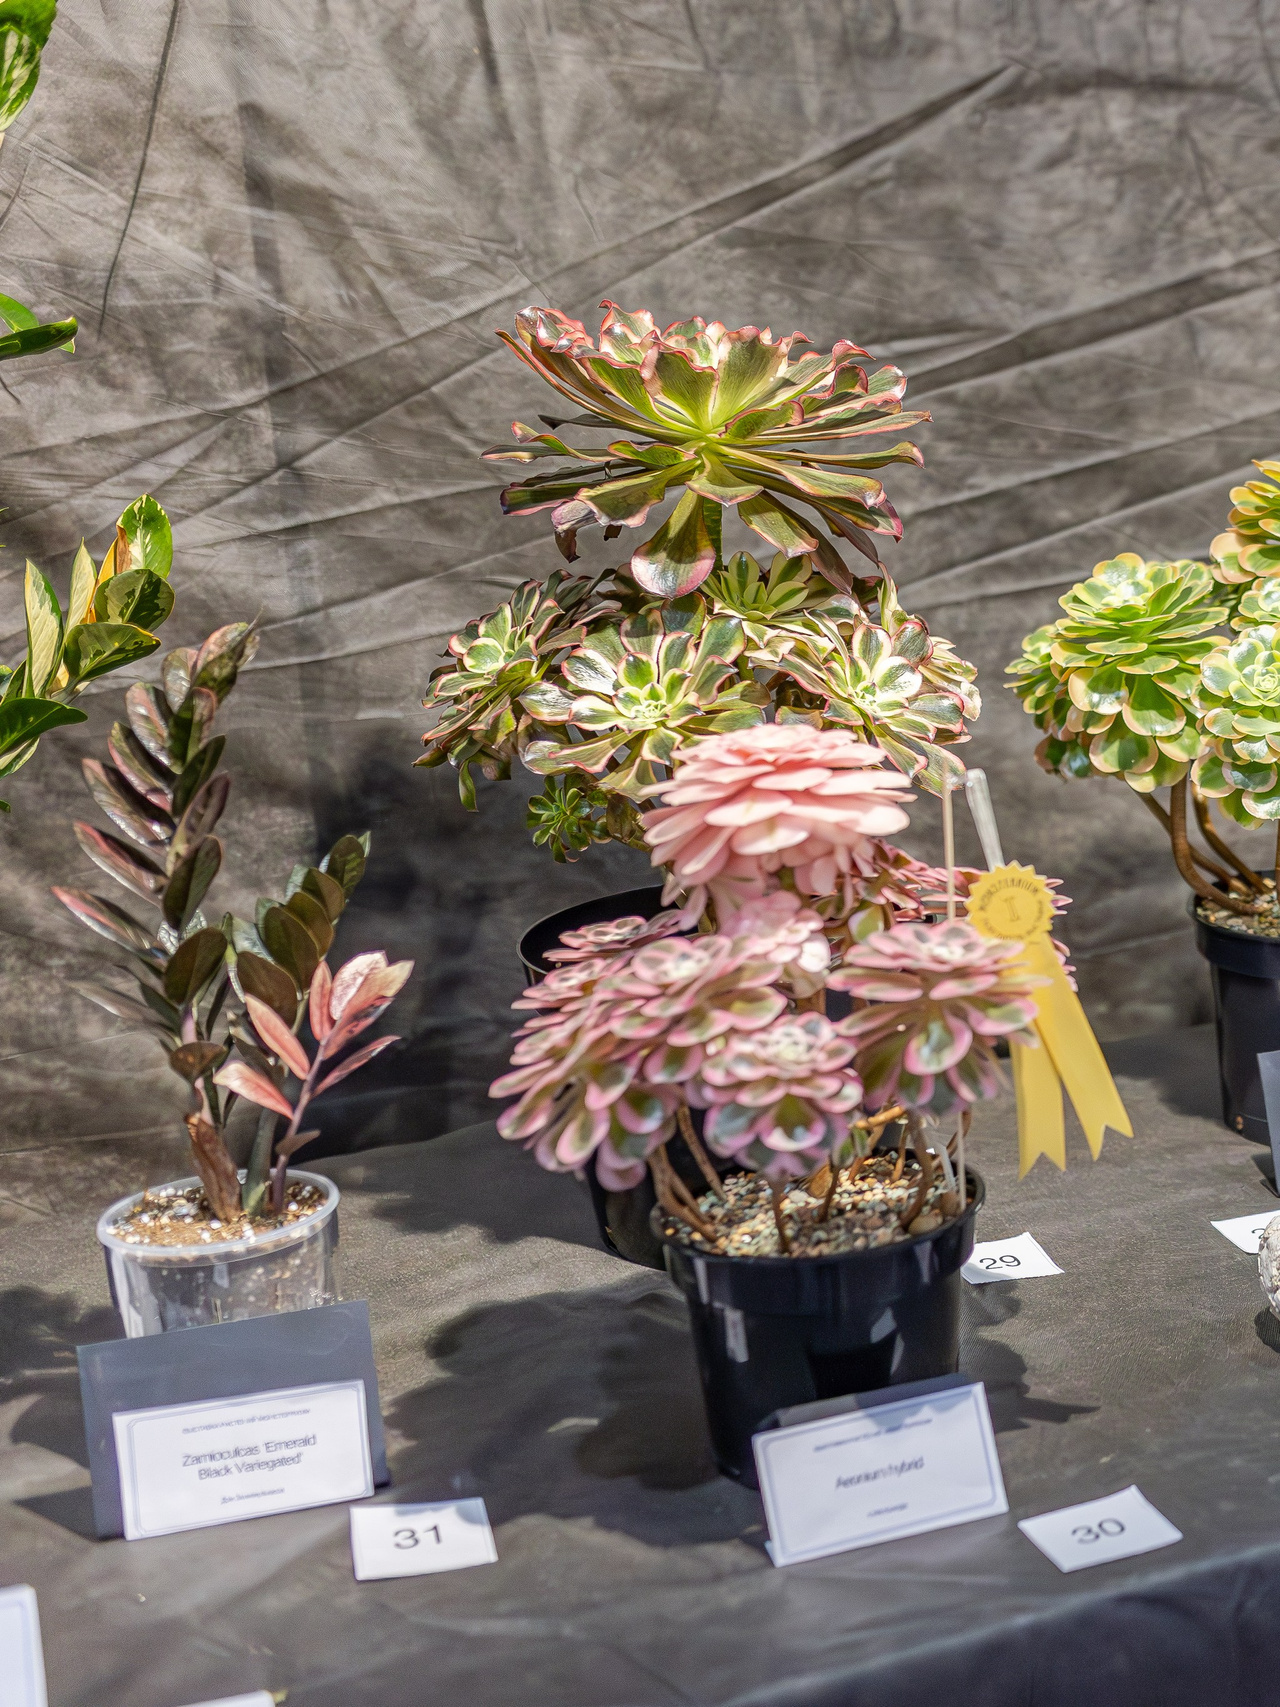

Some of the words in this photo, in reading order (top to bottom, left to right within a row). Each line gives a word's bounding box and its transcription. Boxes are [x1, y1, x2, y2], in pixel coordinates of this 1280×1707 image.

[979, 1254, 1021, 1270] 29
[198, 1465, 232, 1480] Black
[394, 1523, 442, 1549] 31
[1071, 1518, 1125, 1544] 30
